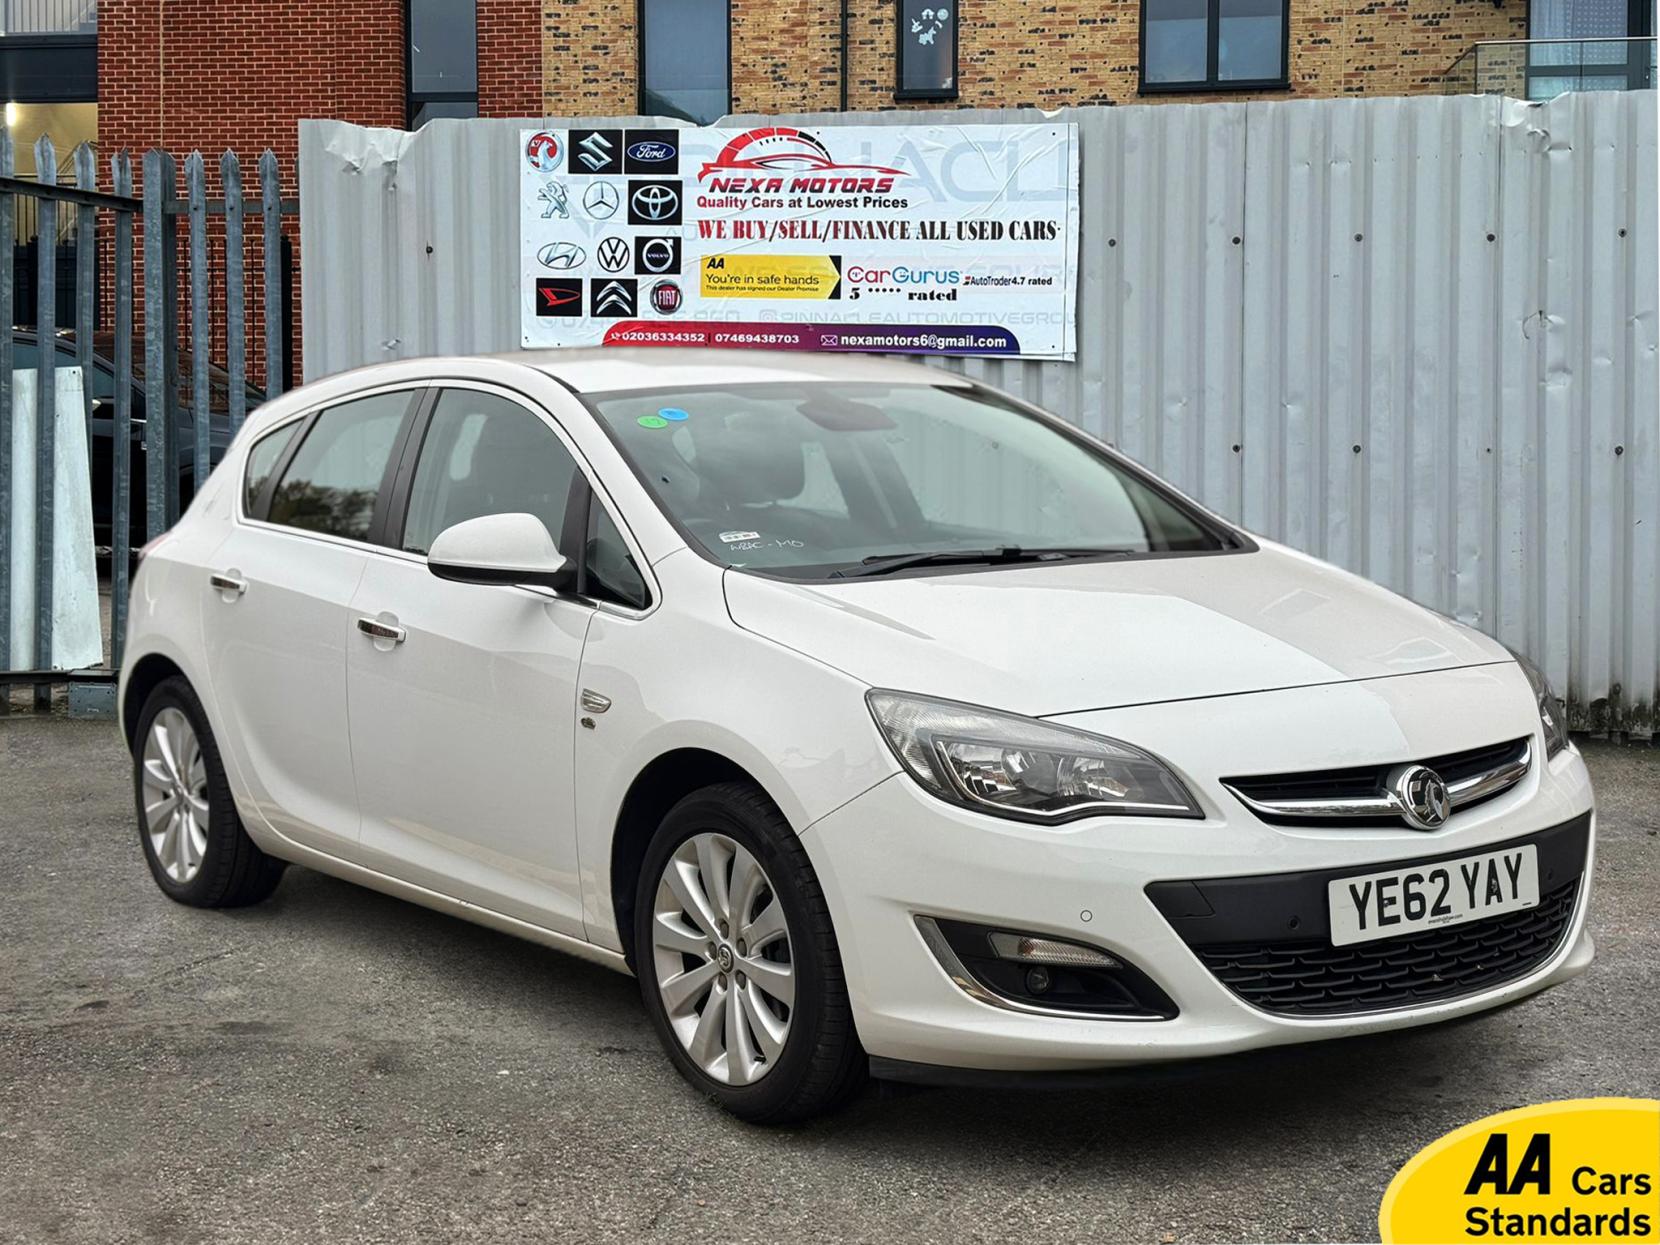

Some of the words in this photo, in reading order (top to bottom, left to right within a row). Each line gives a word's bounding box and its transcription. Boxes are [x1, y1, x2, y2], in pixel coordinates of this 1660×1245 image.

[636, 144, 666, 158] Ford
[709, 178, 784, 194] NEXA
[789, 178, 895, 194] MOTORS
[697, 196, 747, 210] Quality
[751, 196, 784, 208] Cars
[788, 197, 803, 208] at
[807, 197, 858, 209] Lowest
[863, 197, 908, 208] Prices
[697, 219, 727, 239] WE
[916, 221, 951, 240] ALL
[956, 221, 1004, 240] USED
[1009, 220, 1057, 240] CARS
[706, 257, 725, 269] AA
[705, 273, 741, 284] You're
[744, 274, 754, 284] in
[757, 274, 781, 285] safe
[784, 275, 820, 285] hands
[847, 266, 960, 284] CarGurus
[1028, 277, 1053, 286] rated
[658, 290, 677, 306] FIAT
[849, 287, 860, 300] 5
[908, 288, 958, 301] rated
[621, 333, 705, 343] 02036334352
[714, 333, 800, 344] 07469438703
[841, 334, 1007, 349] nexamotors6@gmail.com
[1349, 867, 1452, 931] YE62
[1460, 852, 1523, 910] YAY
